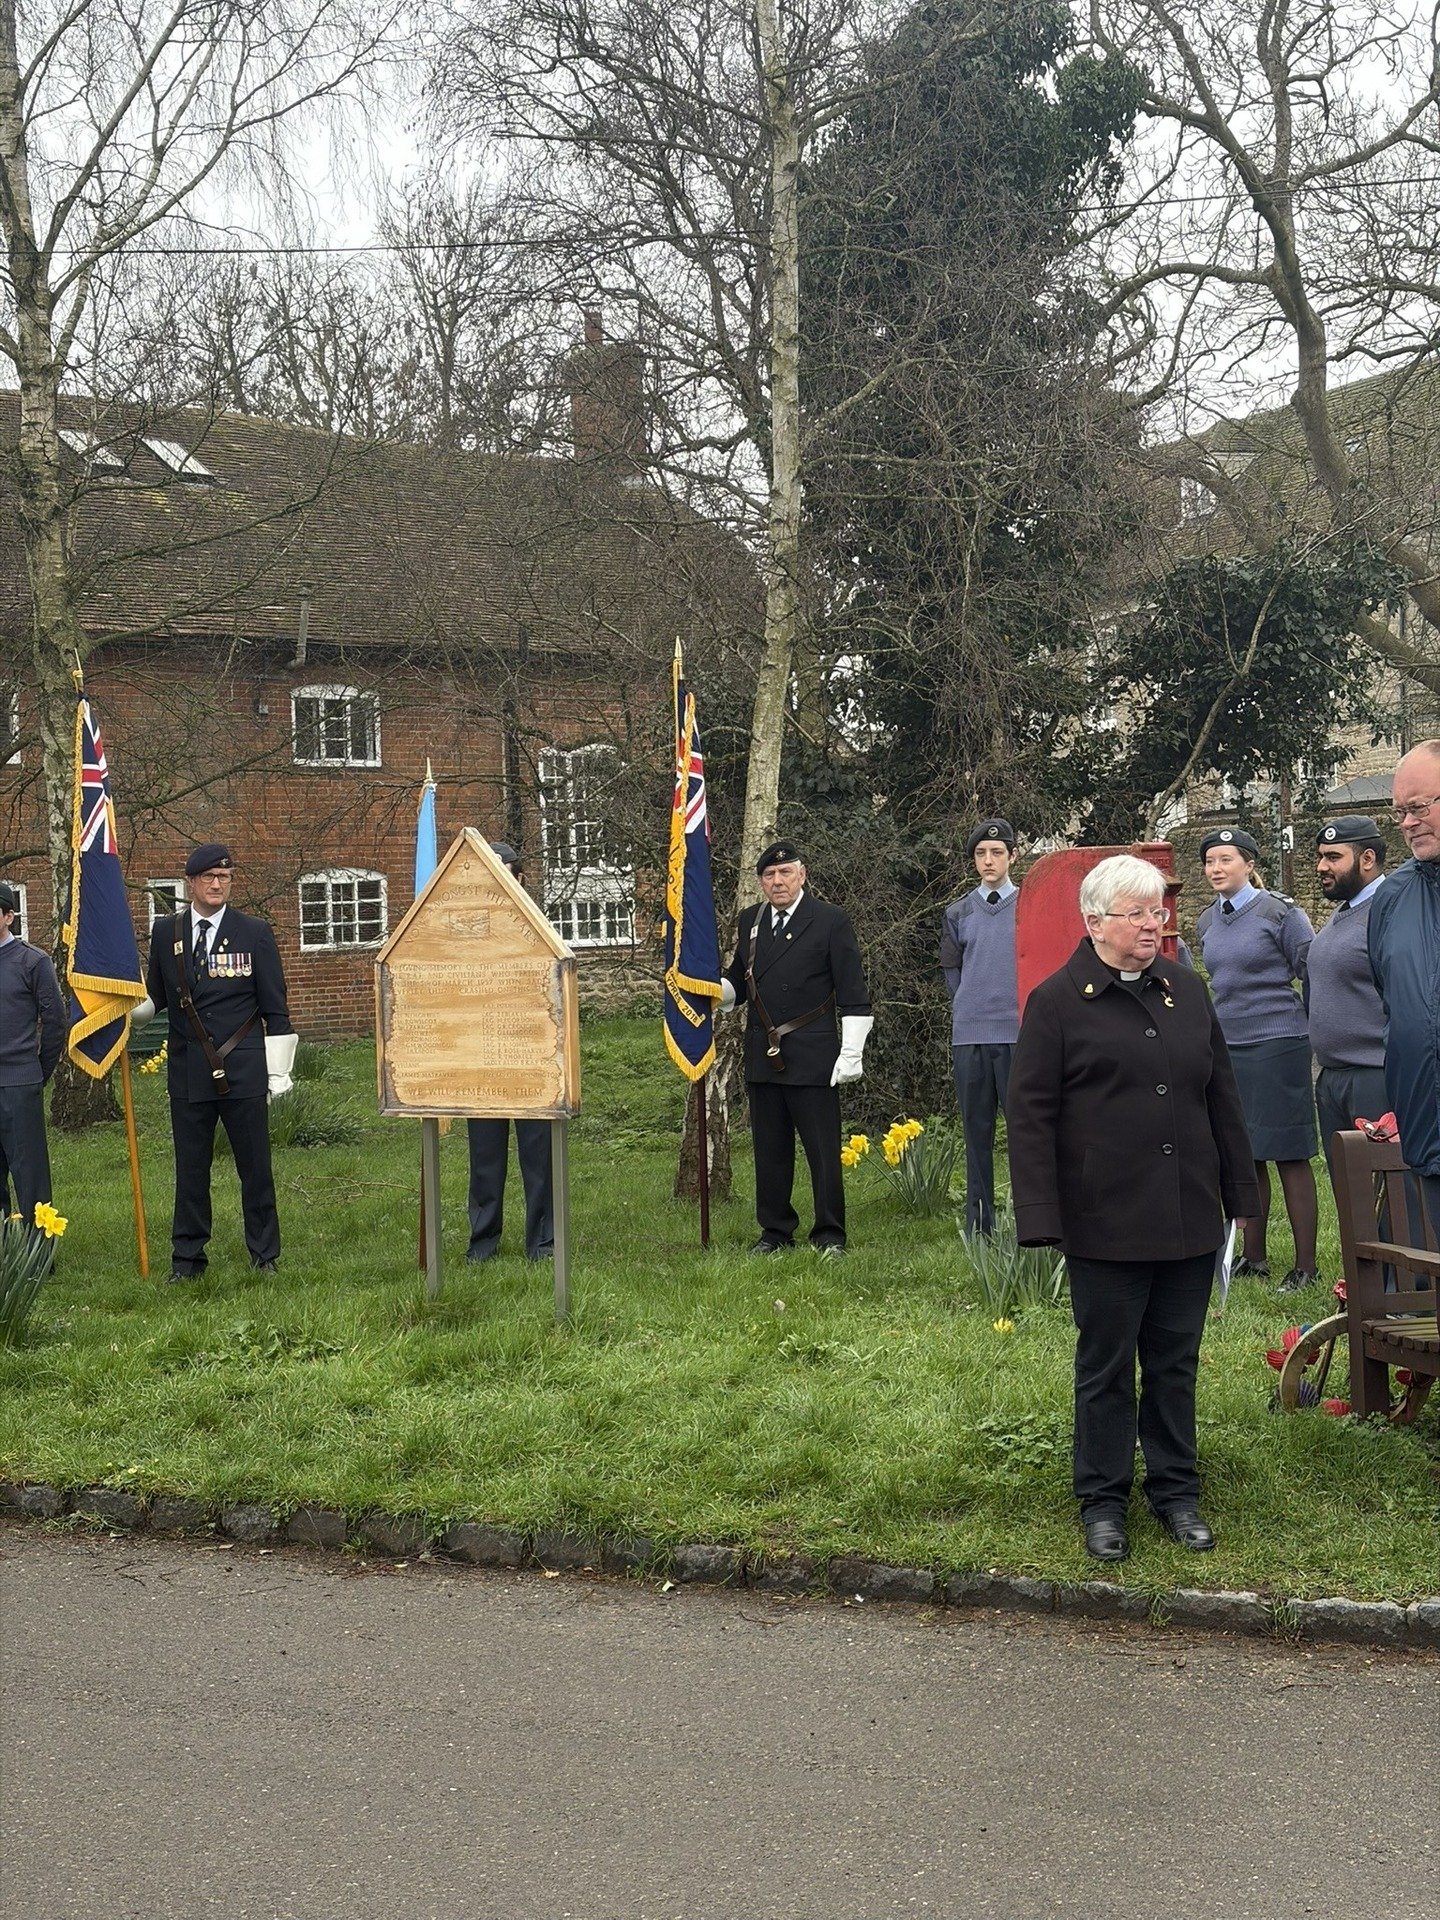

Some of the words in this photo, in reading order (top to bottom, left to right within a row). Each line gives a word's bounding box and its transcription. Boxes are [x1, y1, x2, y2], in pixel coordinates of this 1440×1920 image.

[426, 884, 481, 917] AMONGST
[485, 888, 508, 908] THE
[507, 907, 541, 947] STARS
[429, 963, 462, 972] MEMORY
[479, 963, 494, 972] THE
[447, 970, 487, 980] CIVILIANS
[490, 970, 511, 979] WHO
[459, 986, 494, 995] CRASHED
[667, 976, 682, 1004] YPRES
[682, 1005, 699, 1023] 2018
[408, 1086, 423, 1097] WE
[428, 1086, 452, 1097] WILL
[455, 1086, 509, 1097] REMEMBER
[513, 1086, 543, 1098] THEM
